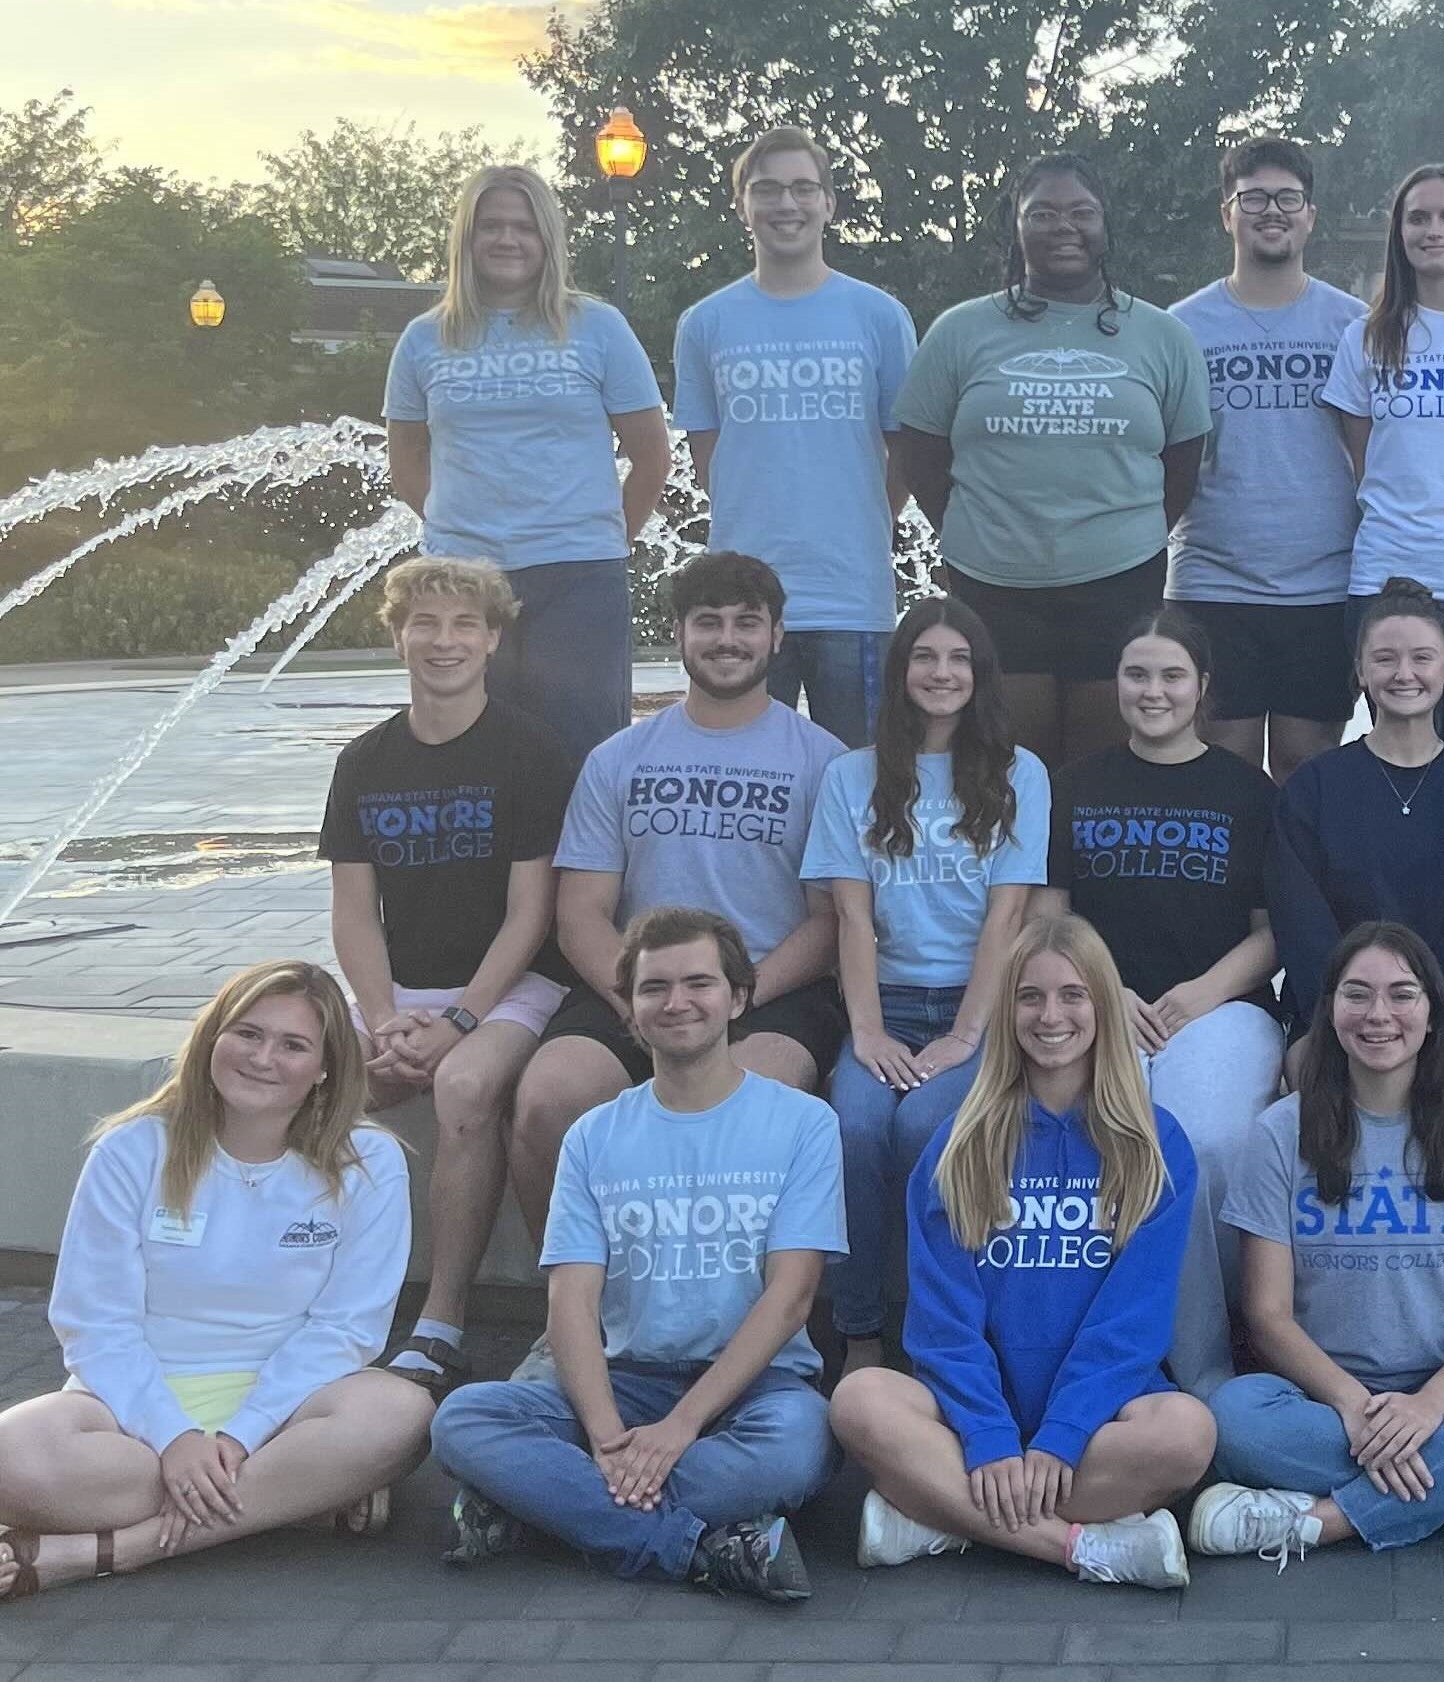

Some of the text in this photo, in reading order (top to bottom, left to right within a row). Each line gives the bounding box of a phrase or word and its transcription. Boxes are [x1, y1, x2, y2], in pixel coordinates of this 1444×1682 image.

[1204, 341, 1337, 358] INDIANA STATE UNIVERS
[1208, 354, 1335, 383] HONOR
[1008, 381, 1115, 398] INDIANA
[1210, 384, 1329, 411] COLLE
[729, 391, 865, 424] OLLEGE
[1022, 398, 1095, 416] STATE
[985, 416, 1130, 436] UNIVERSITY
[685, 764, 722, 776] STATE
[725, 767, 796, 783] UNIVERSITY
[627, 777, 792, 815] HONORS
[359, 799, 494, 838] HONORS
[628, 808, 787, 846] COLLEGE
[1072, 806, 1234, 826] INDIANA STATE UNIVERSITY
[369, 831, 494, 868] COLLGE
[1071, 819, 1231, 856] HONORS
[871, 853, 992, 888] OLLEG
[1075, 849, 1229, 885] COLLEGE
[591, 1170, 786, 1197] NDIANA STATE UNIVERSITY
[1020, 1176, 1060, 1190] STATE
[977, 1235, 1114, 1269] OLLEG
[1302, 1250, 1380, 1272] HONORS
